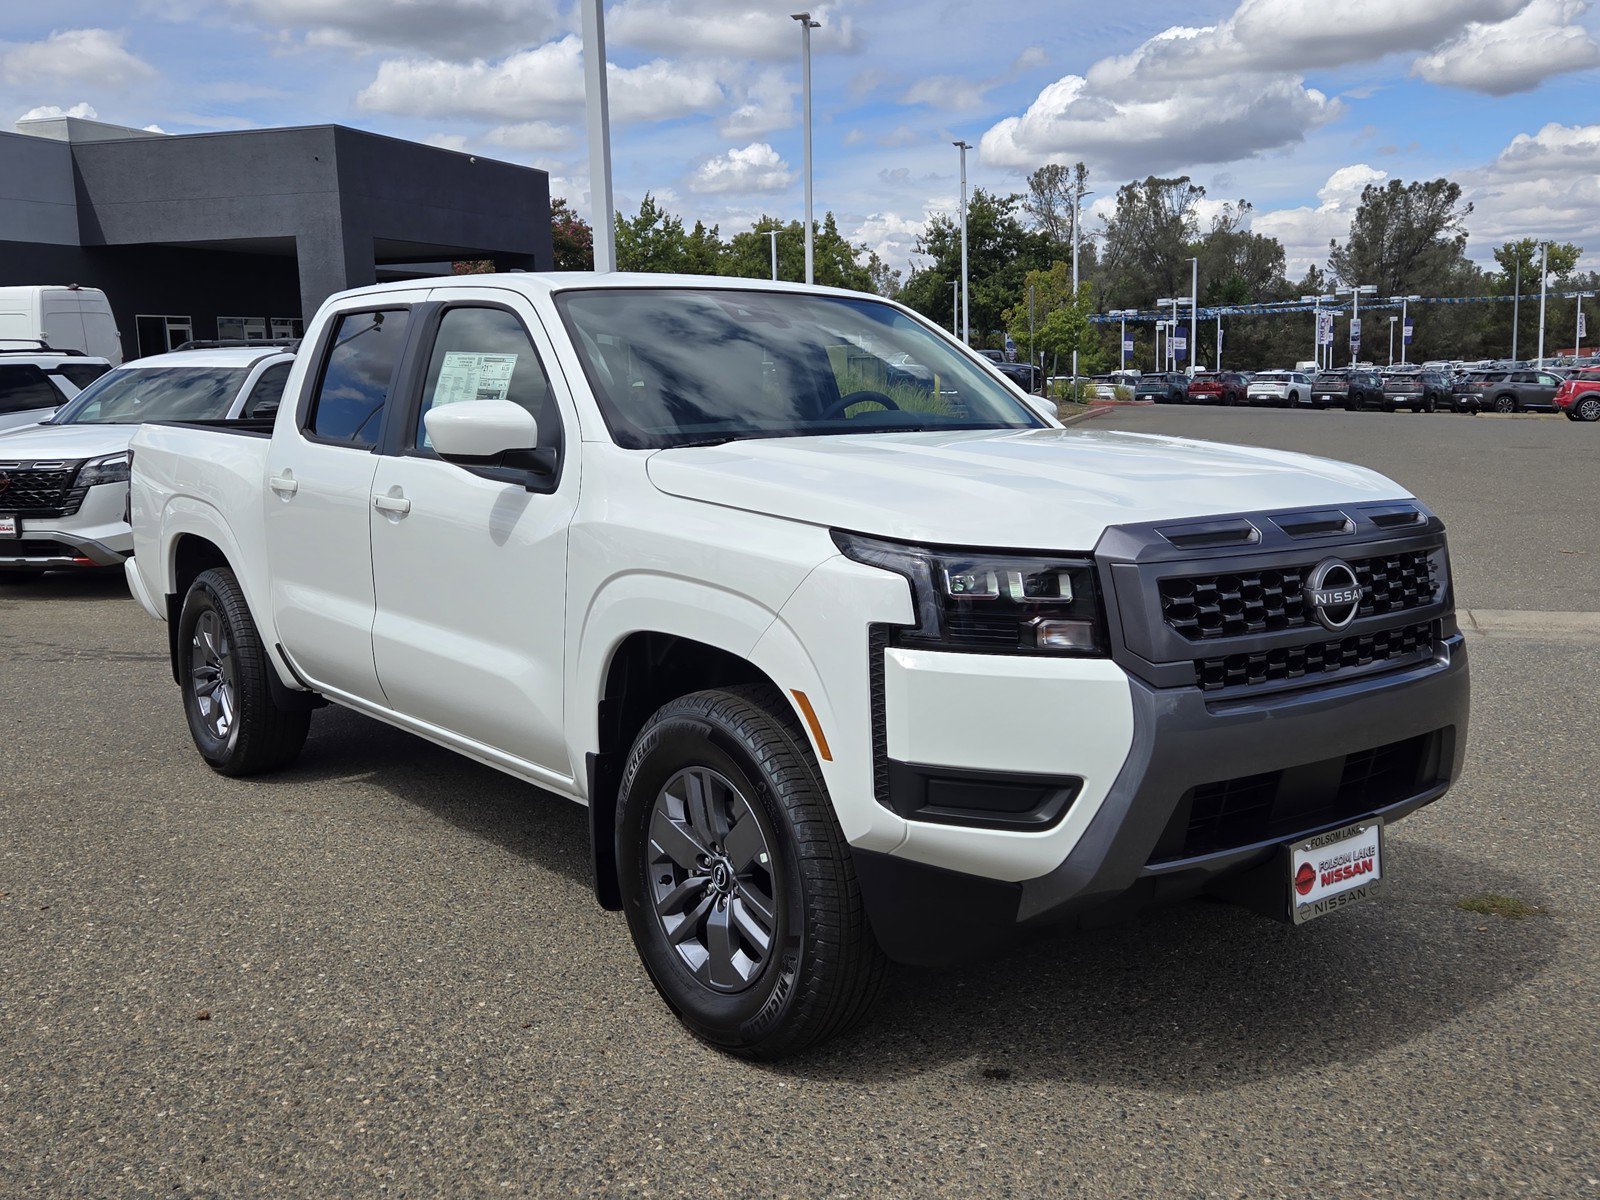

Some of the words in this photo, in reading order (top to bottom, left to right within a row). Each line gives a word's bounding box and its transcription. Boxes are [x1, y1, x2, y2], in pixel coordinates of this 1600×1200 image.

[1315, 588, 1364, 605] NISSAN
[1310, 832, 1341, 847] FOLSOM
[1342, 825, 1361, 837] LAKE
[1318, 853, 1352, 873] FOLSOM
[1352, 845, 1376, 862] LAKE
[1320, 858, 1373, 887] NISSAN
[1314, 888, 1366, 915] NISSAN
